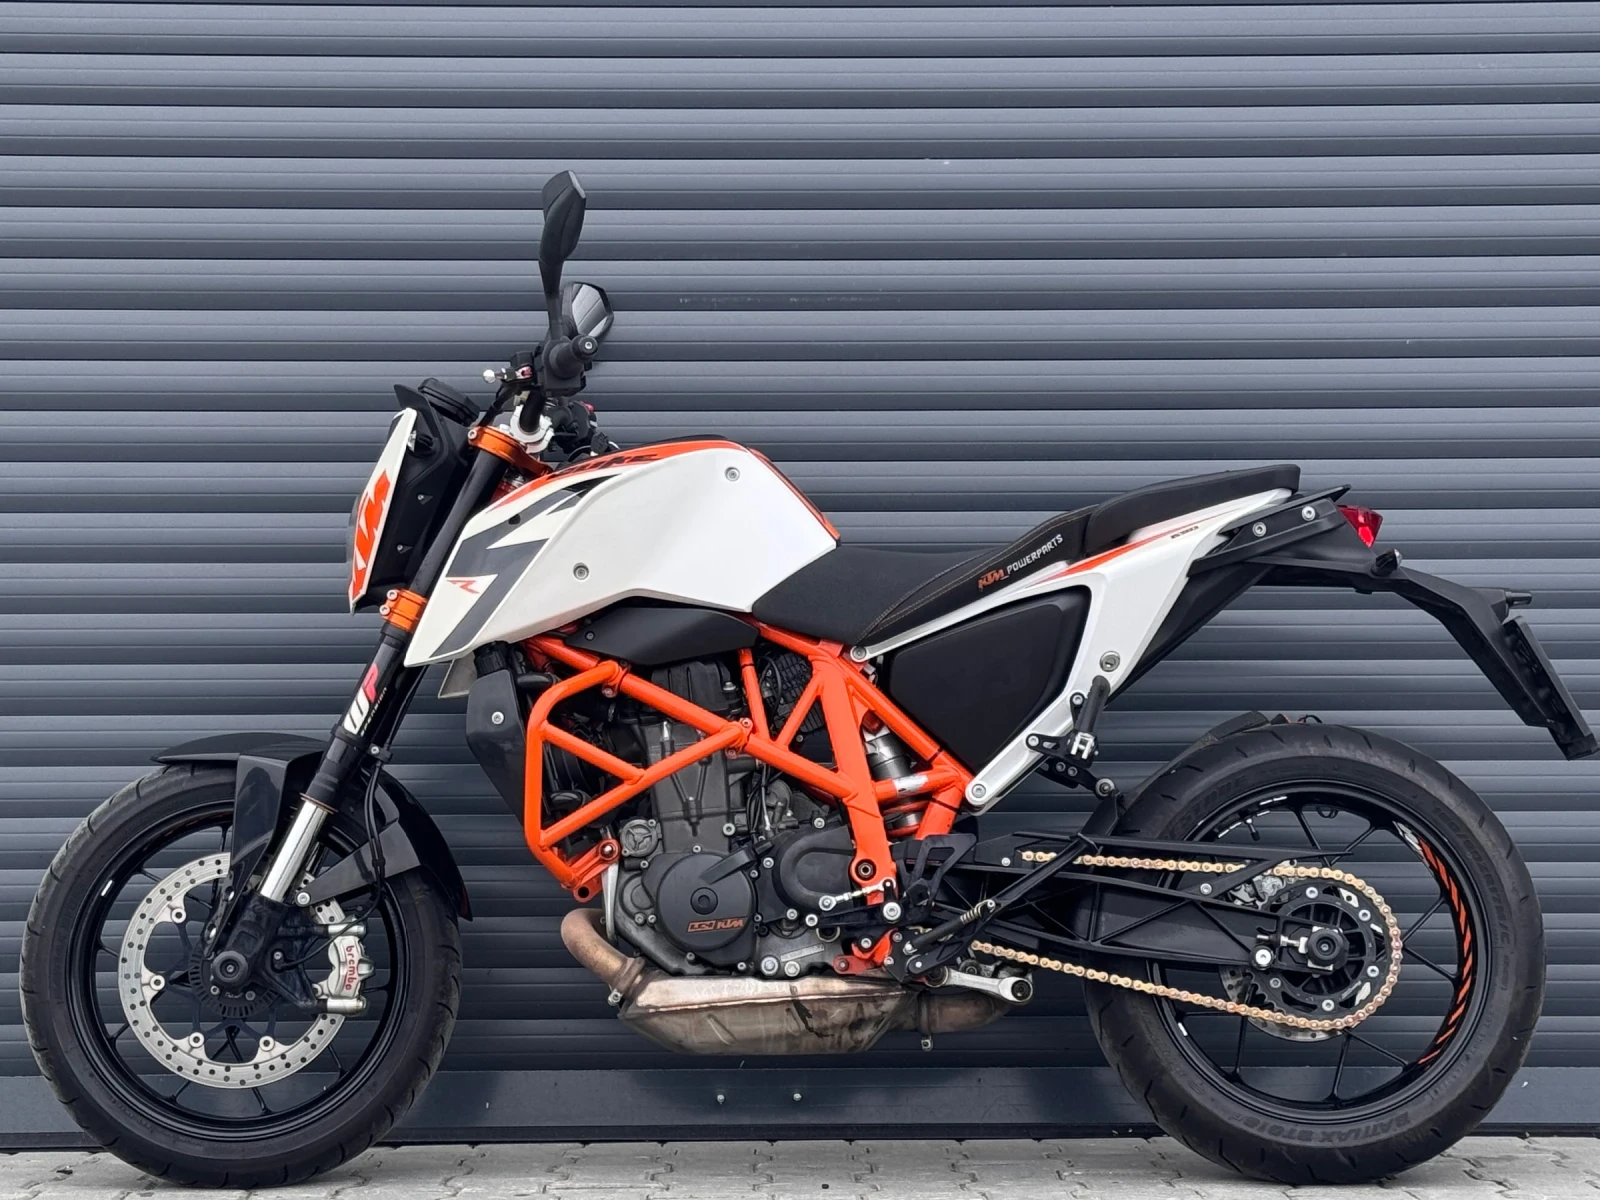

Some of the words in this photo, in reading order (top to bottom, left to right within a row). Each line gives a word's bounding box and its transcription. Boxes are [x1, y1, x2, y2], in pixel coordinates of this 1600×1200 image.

[978, 569, 1005, 590] KTM
[1006, 533, 1064, 575] POWERPARTS
[345, 945, 358, 991] brembo
